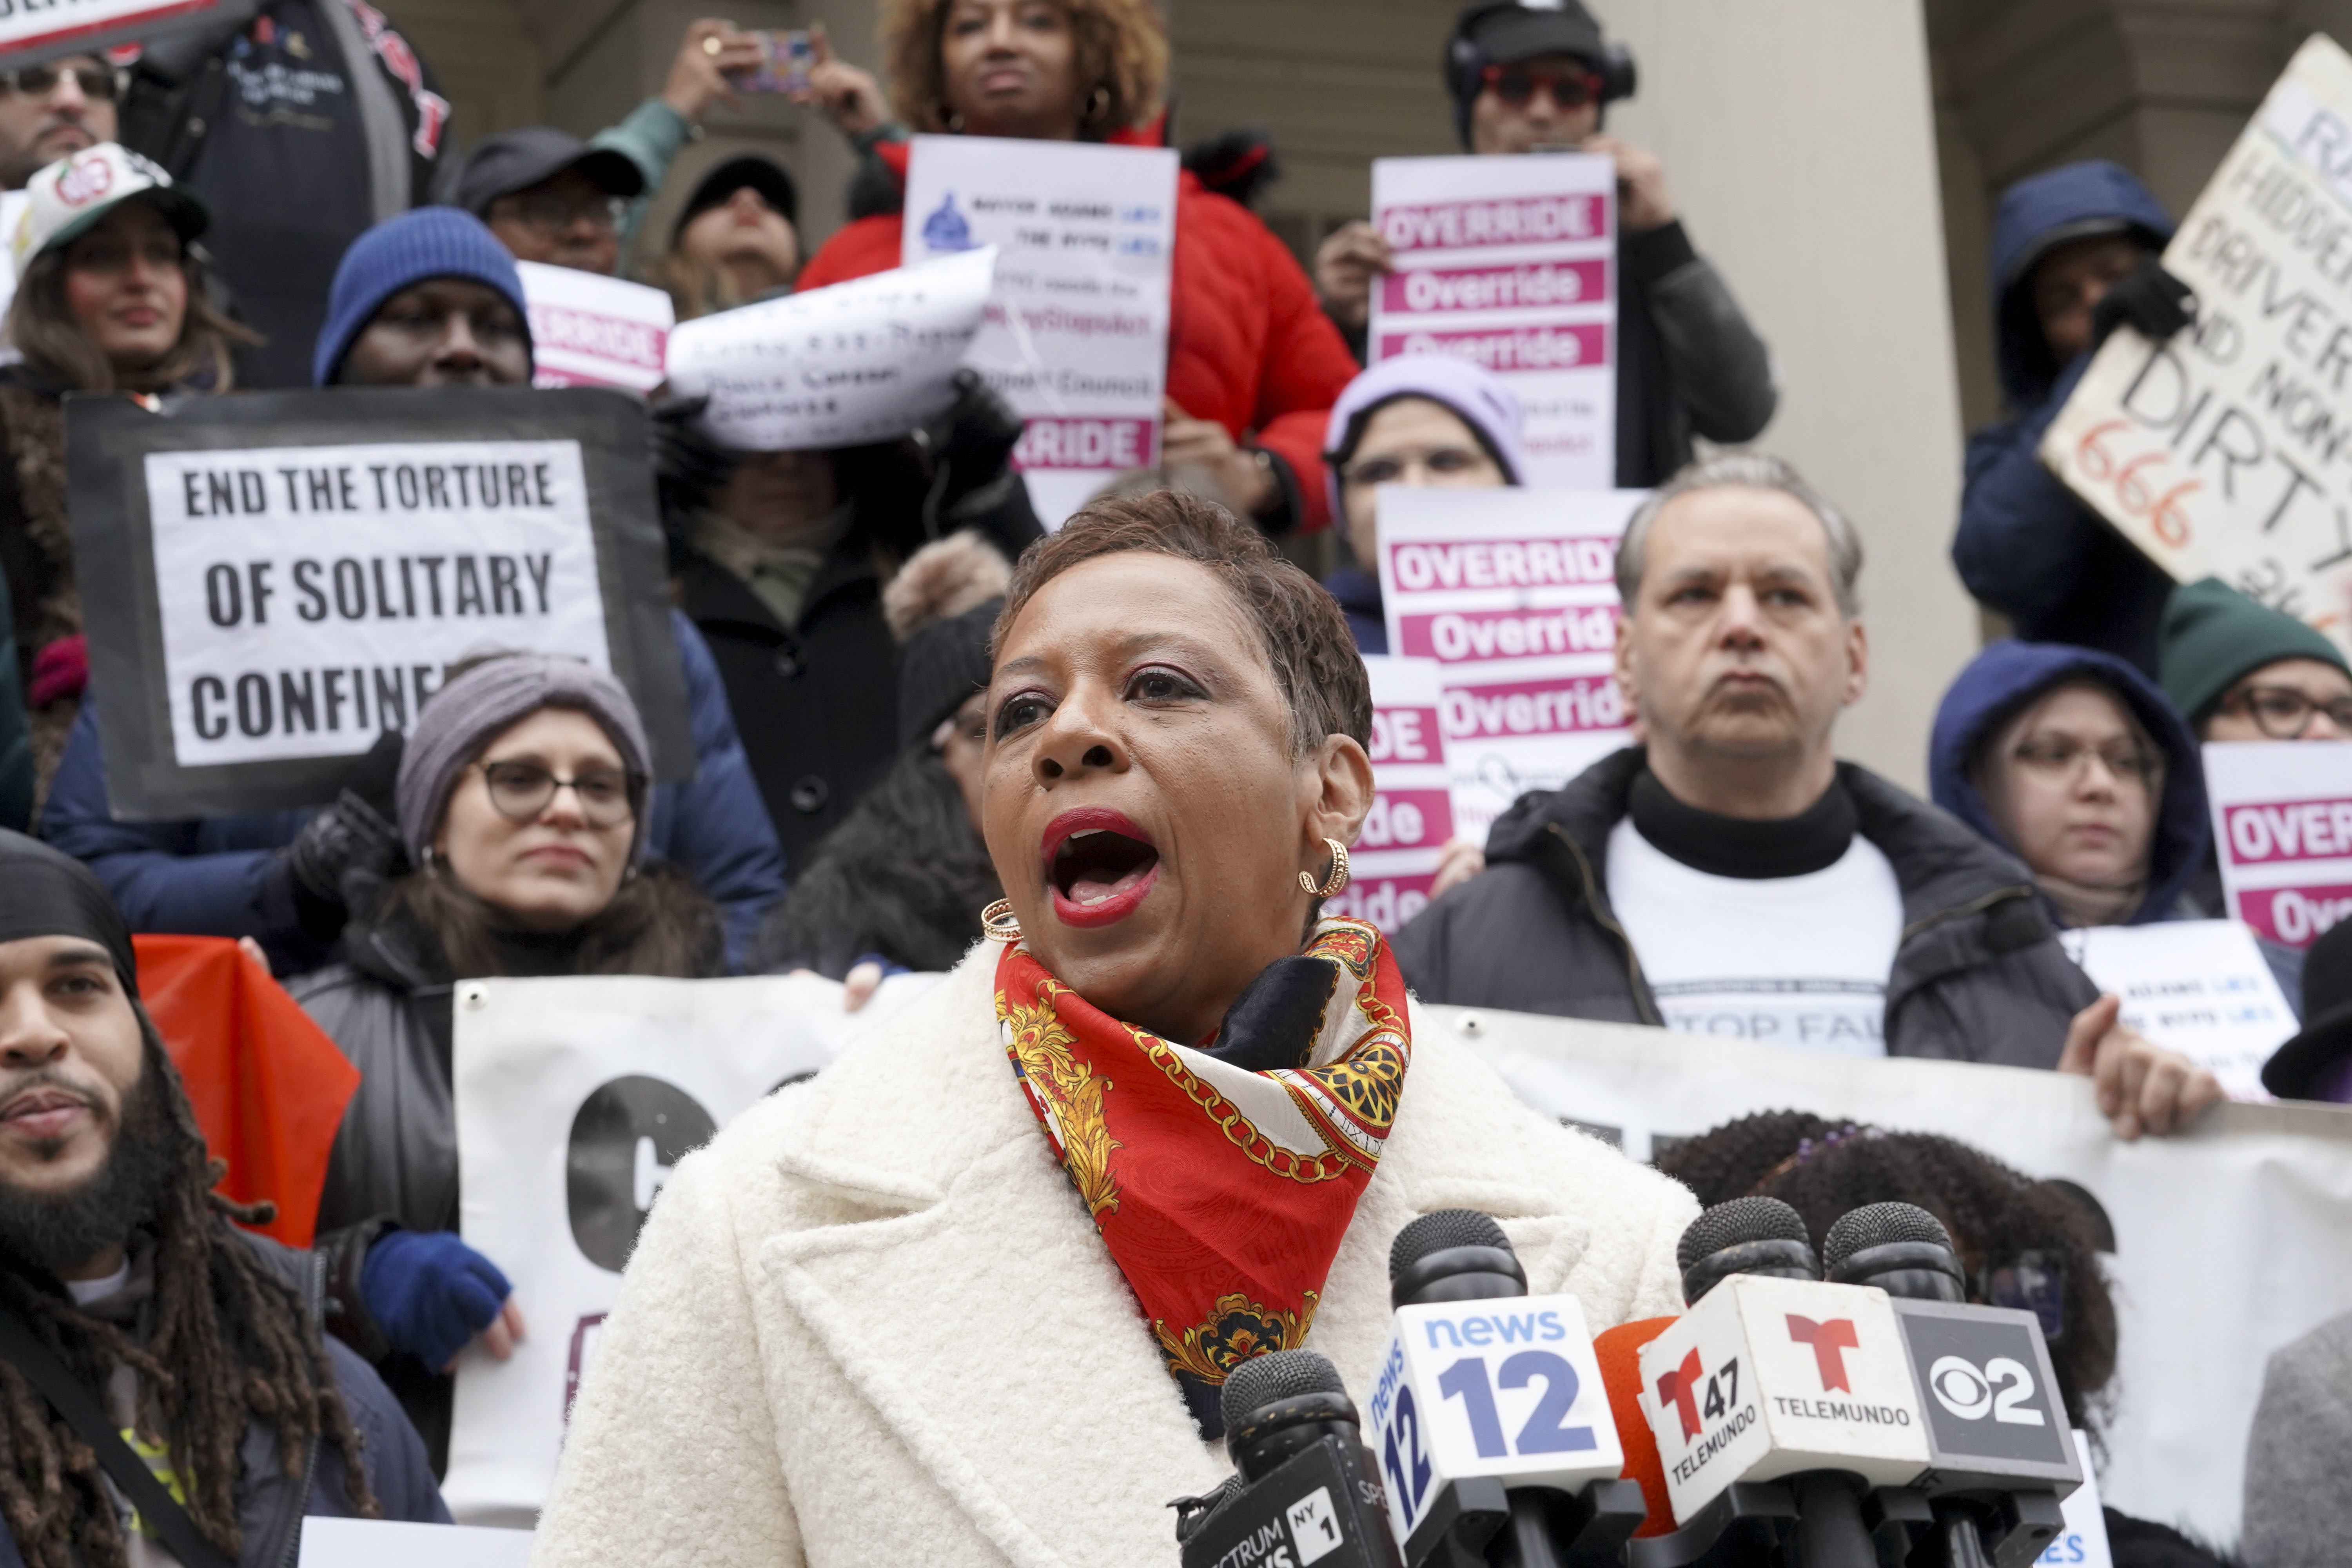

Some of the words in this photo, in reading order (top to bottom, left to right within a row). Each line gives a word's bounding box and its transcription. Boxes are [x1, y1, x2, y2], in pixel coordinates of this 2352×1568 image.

[1385, 198, 1592, 248] OVERRIDE
[1404, 264, 1582, 310] Override
[182, 470, 267, 518] END
[279, 468, 358, 513] THE
[368, 462, 555, 510] TORTURE
[2077, 419, 2204, 549] 666
[206, 561, 276, 627] OF
[293, 553, 552, 621] SOLITARY
[1397, 539, 1620, 592] OVERRID
[1431, 606, 1616, 661] Overrid
[191, 663, 435, 741] CONFINE
[1442, 680, 1622, 737] Overrid
[1424, 1310, 1566, 1348] news
[1371, 1338, 1404, 1432] news
[1438, 1350, 1598, 1459] 12
[1704, 1356, 1740, 1421] 47
[1773, 1396, 1910, 1426] TELEMUNDO
[1985, 1357, 2045, 1426] 2
[1385, 1385, 1432, 1532] 12
[1671, 1404, 1757, 1486] TELEMUNDO
[1211, 1516, 1284, 1568] CTRUM
[1293, 1501, 1315, 1528] NY
[1320, 1516, 1336, 1541] 1
